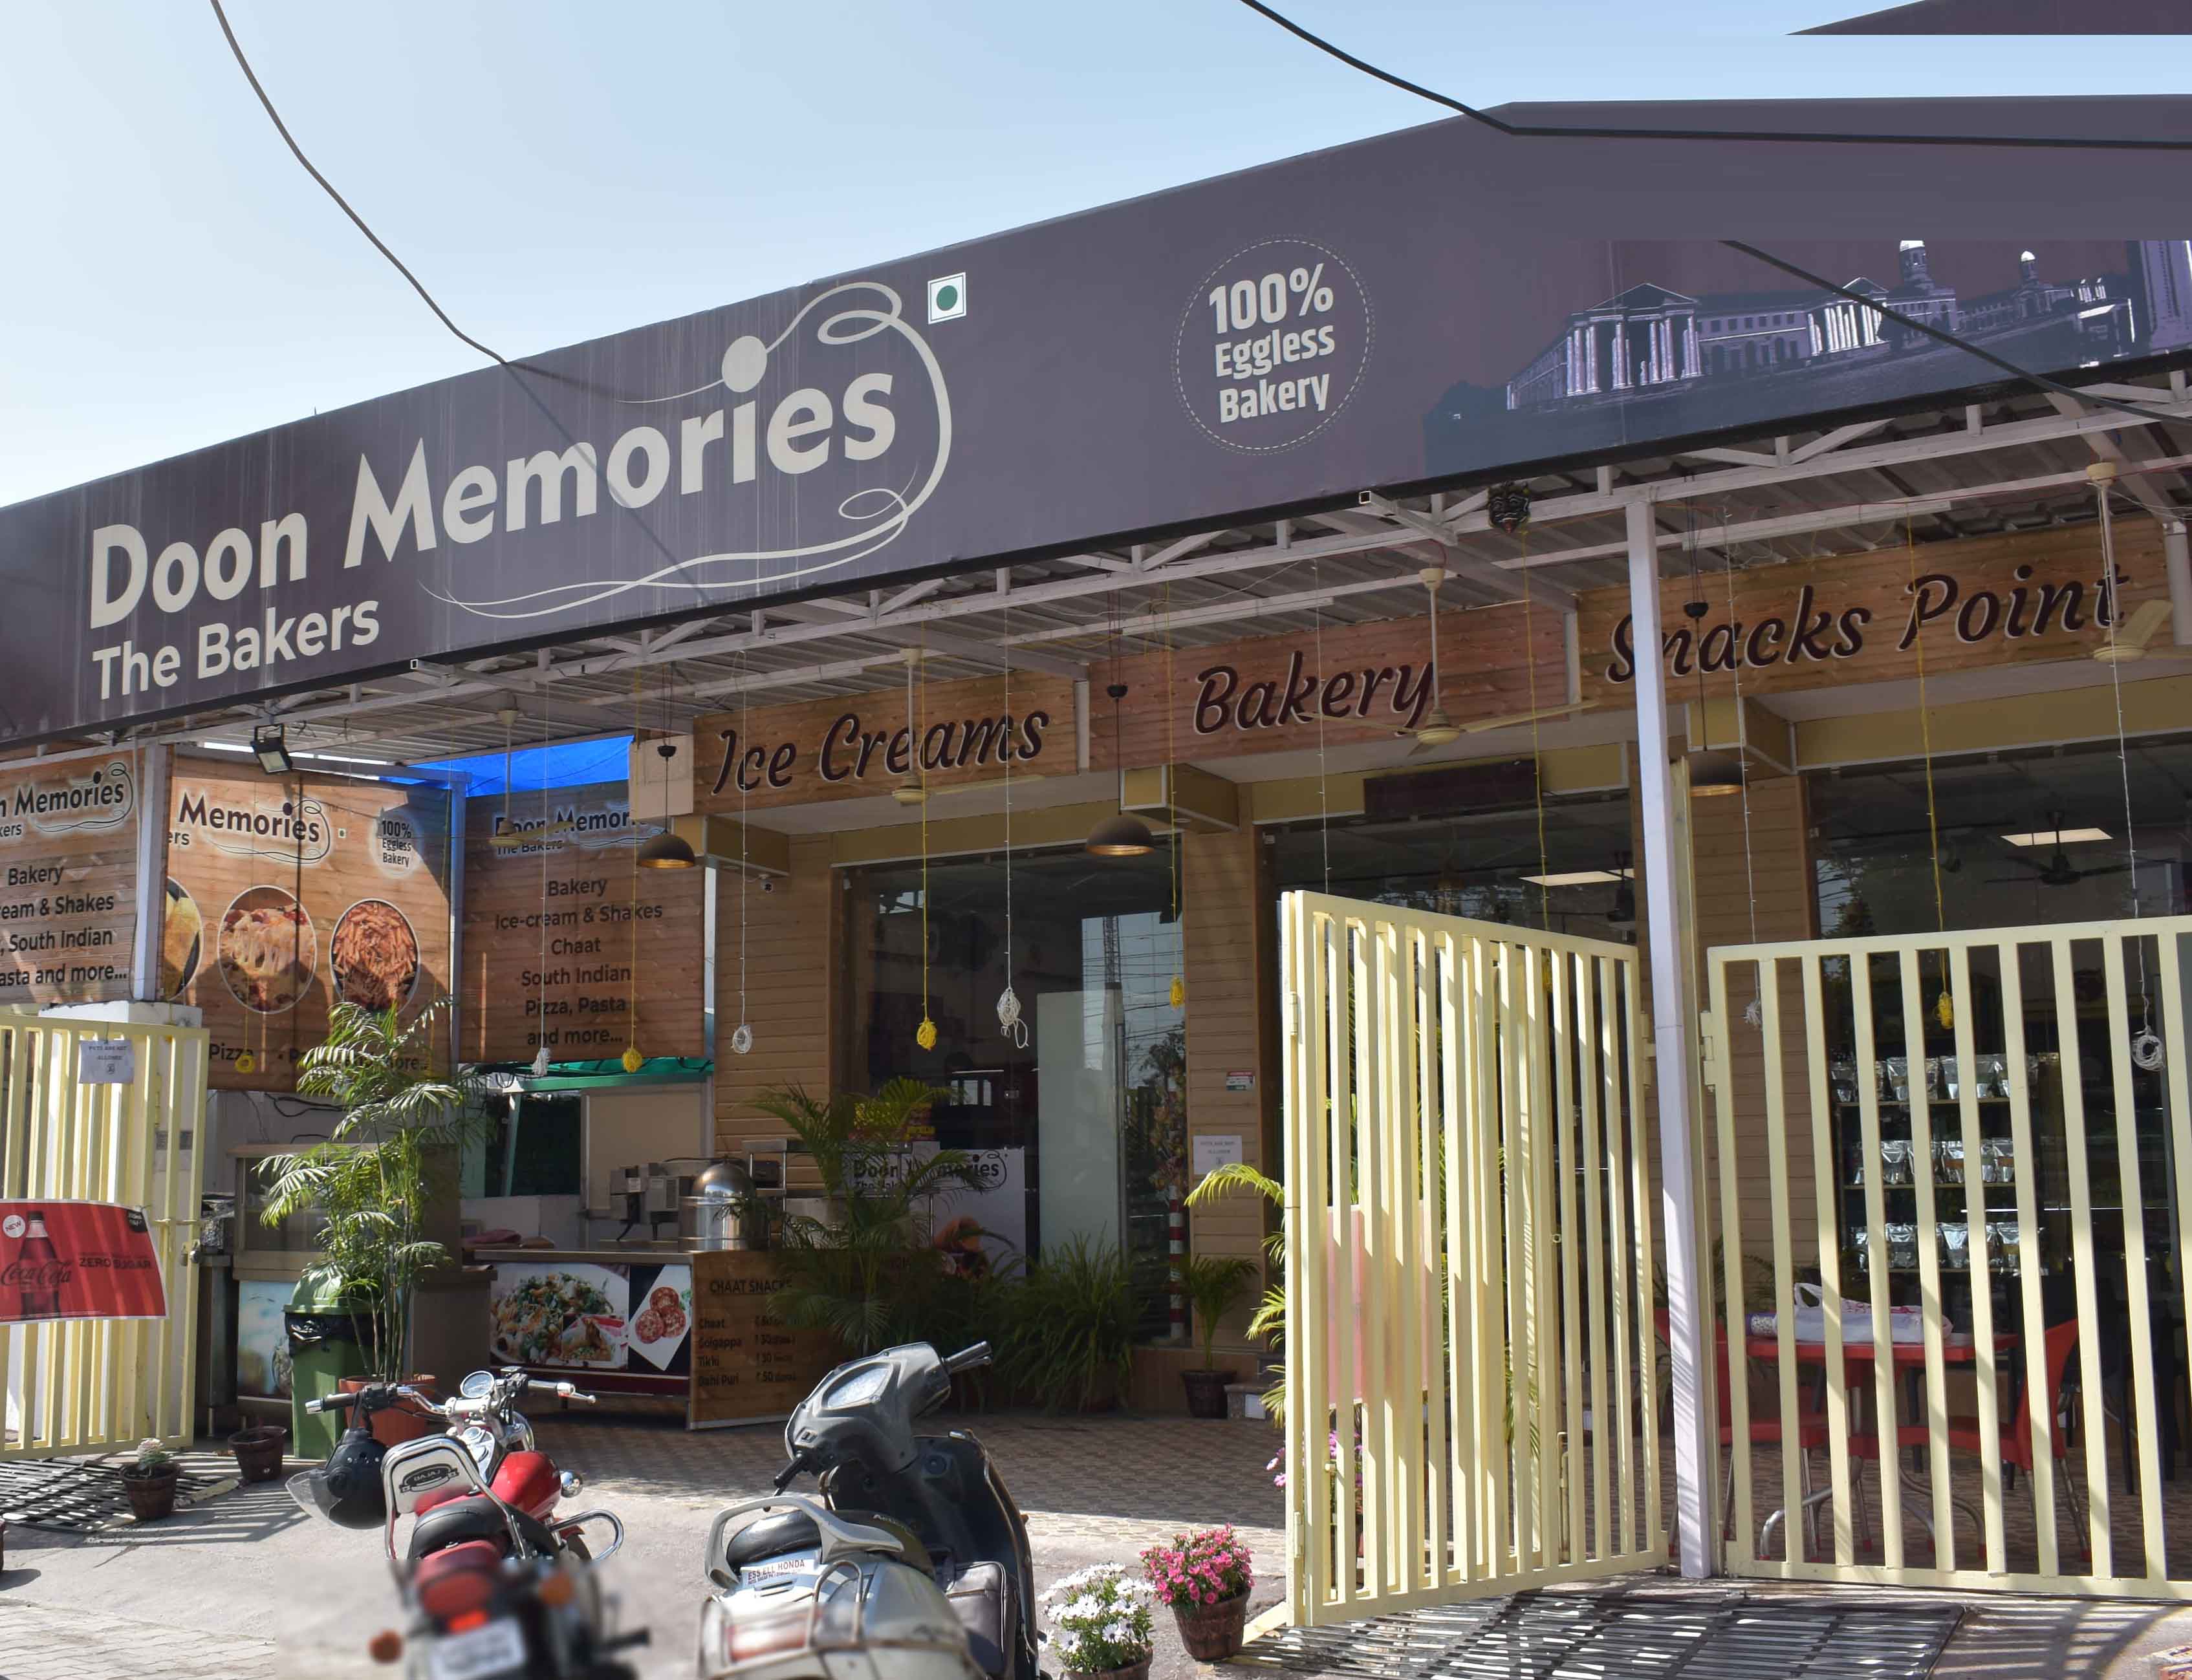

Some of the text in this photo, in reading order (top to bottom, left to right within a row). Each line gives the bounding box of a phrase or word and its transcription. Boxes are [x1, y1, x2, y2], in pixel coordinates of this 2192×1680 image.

[1208, 263, 1334, 334] 100%
[1215, 325, 1336, 380] Eggless
[1219, 372, 1330, 424] Bakery
[90, 335, 896, 630] Doon Memories
[1605, 563, 2131, 685] Snacks Point
[92, 600, 380, 701] The Bakers
[1193, 650, 1434, 737] Bakery
[711, 711, 1050, 796] Ice Creams
[14, 770, 125, 816] Memories
[179, 792, 320, 843] Memories
[381, 819, 412, 838] 100%
[382, 838, 412, 853] Eggless
[382, 852, 409, 867] Bakery
[8, 865, 65, 886] Bakery
[547, 878, 607, 897] Bakery
[39, 898, 50, 916] &
[54, 892, 114, 915] Shakes
[495, 903, 663, 931] Ice-cream & Shakes
[8, 926, 113, 953] South Indian
[551, 936, 602, 956] Chaat
[0, 969, 30, 987] asta
[35, 964, 66, 984] and
[521, 965, 631, 987] South Indian
[525, 996, 627, 1018] Pizza, Pasta
[526, 1029, 559, 1046] and
[5, 1220, 22, 1232] NEW
[78, 1256, 111, 1268] ZERO
[709, 1278, 746, 1294] CHAAT
[748, 1569, 761, 1580] ESS
[777, 1558, 805, 1571] HONDA
